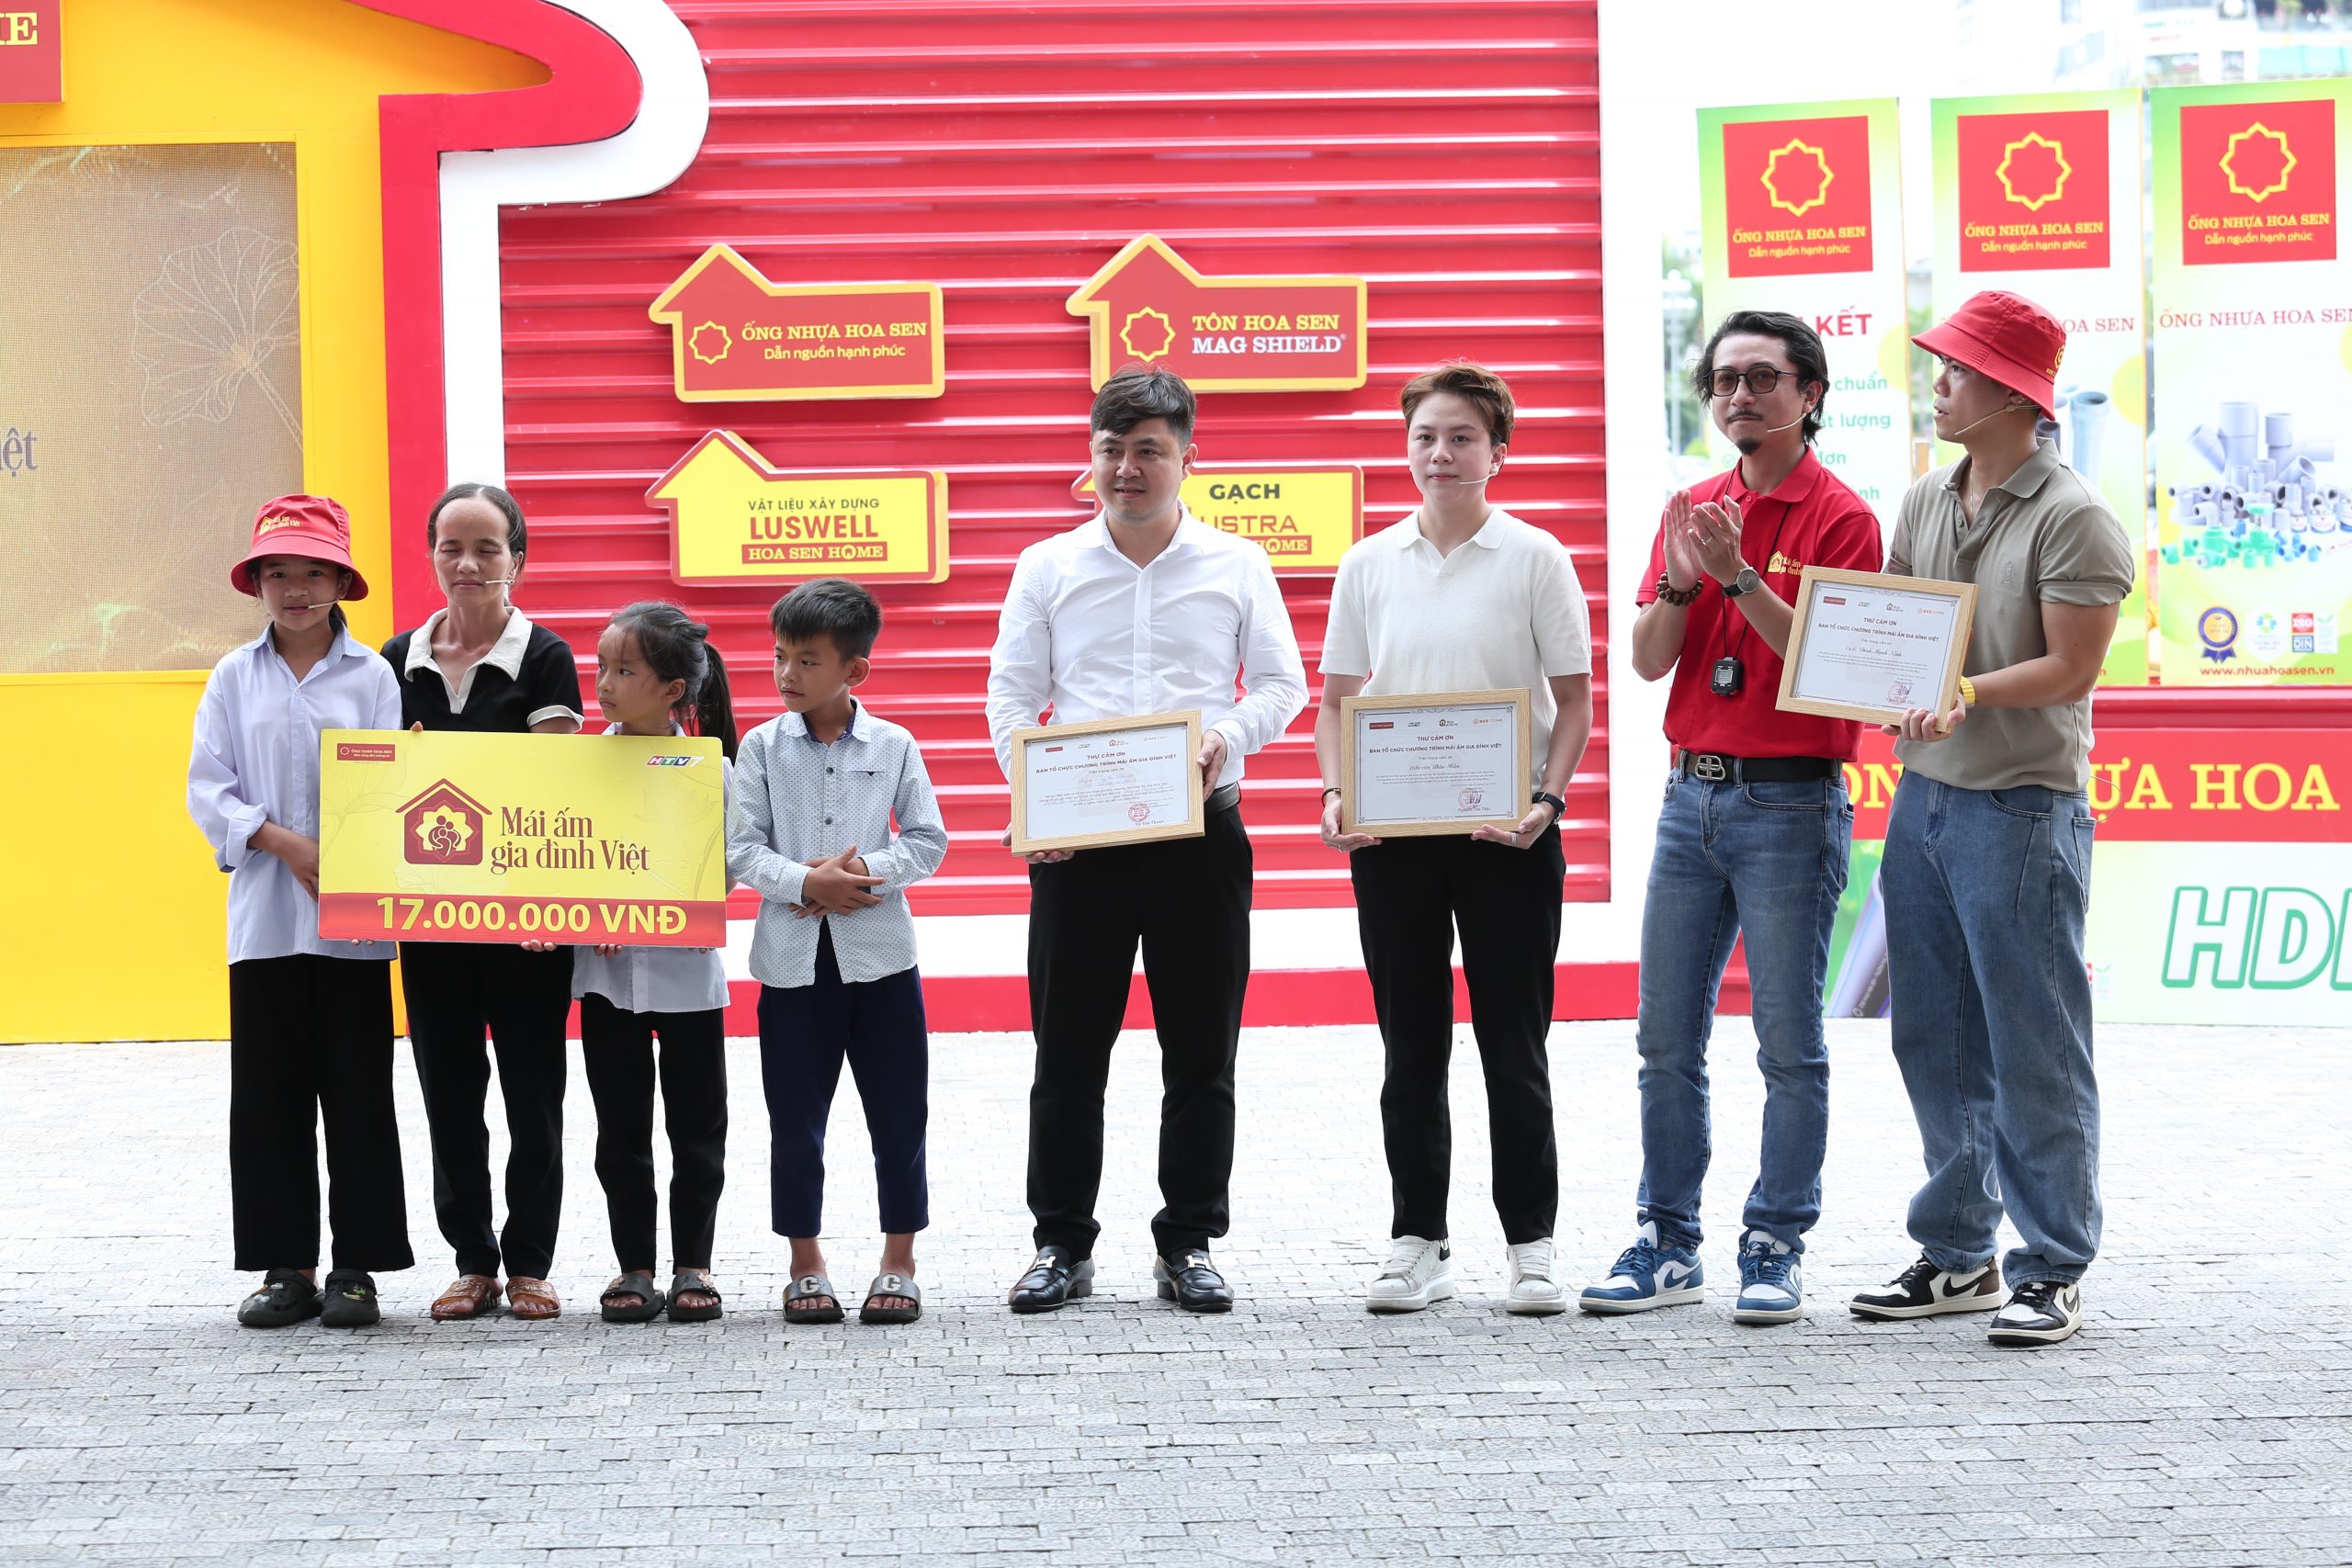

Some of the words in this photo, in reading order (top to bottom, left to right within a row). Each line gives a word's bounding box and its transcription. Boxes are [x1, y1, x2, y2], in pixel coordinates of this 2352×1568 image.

[0, 12, 38, 46] E
[1965, 222, 1996, 237] ỐNG
[1999, 223, 2039, 238] NHỰA
[2041, 223, 2072, 234] HOA
[2075, 222, 2103, 233] SEN
[2188, 214, 2219, 230] ỐNG
[2222, 215, 2263, 230] NHỰA
[2267, 215, 2297, 226] HOA
[2301, 213, 2330, 225] SEN
[1733, 229, 1761, 243] ỐNG
[1765, 230, 1804, 243] NHỰA
[1806, 229, 1836, 240] HOA
[1838, 227, 1866, 238] SEN
[2205, 232, 2225, 244] Dẫn
[2227, 231, 2257, 245] nguồn
[2260, 231, 2286, 243] hạnh
[2287, 231, 2312, 243] phúc
[1748, 246, 1768, 257] Dẫn
[1770, 245, 1798, 258] nguồn
[1801, 244, 1826, 256] hạnh
[1826, 243, 1850, 254] phúc
[1981, 241, 2001, 252] Dẫn
[2003, 239, 2034, 253] nguồn
[2036, 241, 2060, 252] hạnh
[2063, 239, 2087, 250] phúc
[1193, 312, 1238, 331] TÔN
[1244, 315, 1291, 331] HOA
[1296, 314, 1340, 331] SEN
[1816, 306, 1871, 336] KẾT
[2060, 318, 2089, 333] OA
[2095, 318, 2134, 333] SEN
[2159, 307, 2203, 328] ỐNG
[2210, 310, 2267, 329] NHỰA
[2273, 310, 2315, 324] HOA
[2321, 309, 2352, 322] SE
[742, 321, 783, 341] ỐNG
[787, 324, 841, 342] NHỰA
[845, 323, 885, 338] HOA
[889, 322, 926, 336] SEN
[764, 345, 790, 360] Dẫn
[794, 345, 834, 360] nguồn
[837, 345, 870, 360] hạnh
[873, 344, 905, 358] phúc
[1192, 336, 1248, 354] MAG
[1841, 413, 1891, 430] lượng
[1209, 483, 1280, 504] GẠCH
[749, 498, 774, 513] VẬT
[778, 498, 803, 513] LIỆU
[809, 497, 836, 510] XÂY
[842, 497, 880, 512] DỰNG
[750, 514, 878, 540] LUSWELL
[748, 547, 785, 560] HOA
[789, 547, 823, 558] SEN
[828, 544, 883, 559] HOME
[2293, 618, 2313, 627] ISO
[2294, 639, 2312, 649] DIN
[2200, 666, 2334, 676] www.nhuahoasen.vn
[647, 756, 706, 768] HTV7
[2190, 763, 2339, 812] HOA
[500, 807, 546, 837] Mái
[553, 807, 594, 838] ấm
[491, 841, 528, 874] gia
[536, 838, 595, 869] đình
[599, 840, 650, 874] Việt
[377, 897, 591, 932] 17.000.000
[599, 904, 687, 935] VNĐ
